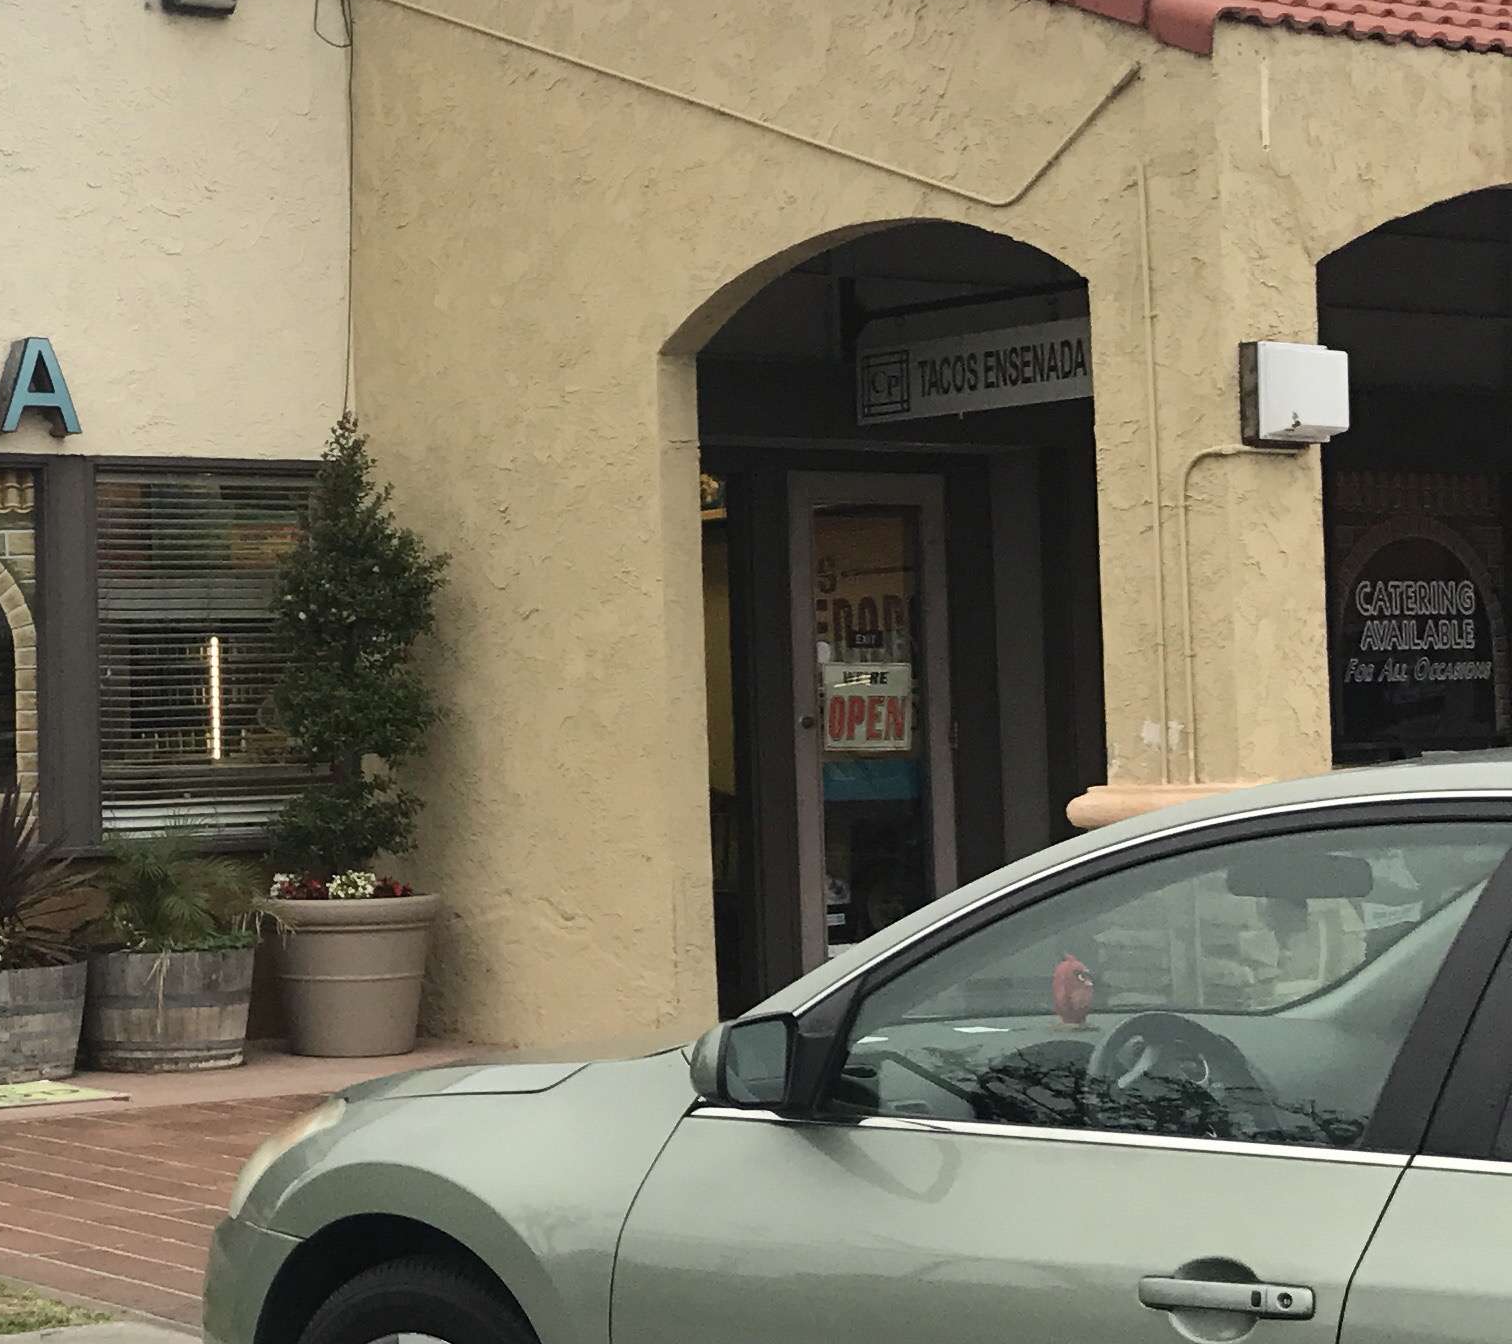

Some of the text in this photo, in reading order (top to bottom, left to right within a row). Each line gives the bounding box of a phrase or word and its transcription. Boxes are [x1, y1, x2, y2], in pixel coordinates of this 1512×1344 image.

[917, 337, 1087, 397] TACOS ENSENADA
[1355, 580, 1476, 616] CATERING
[1360, 619, 1476, 651] AVAILABLE
[828, 695, 906, 741] OPEN
